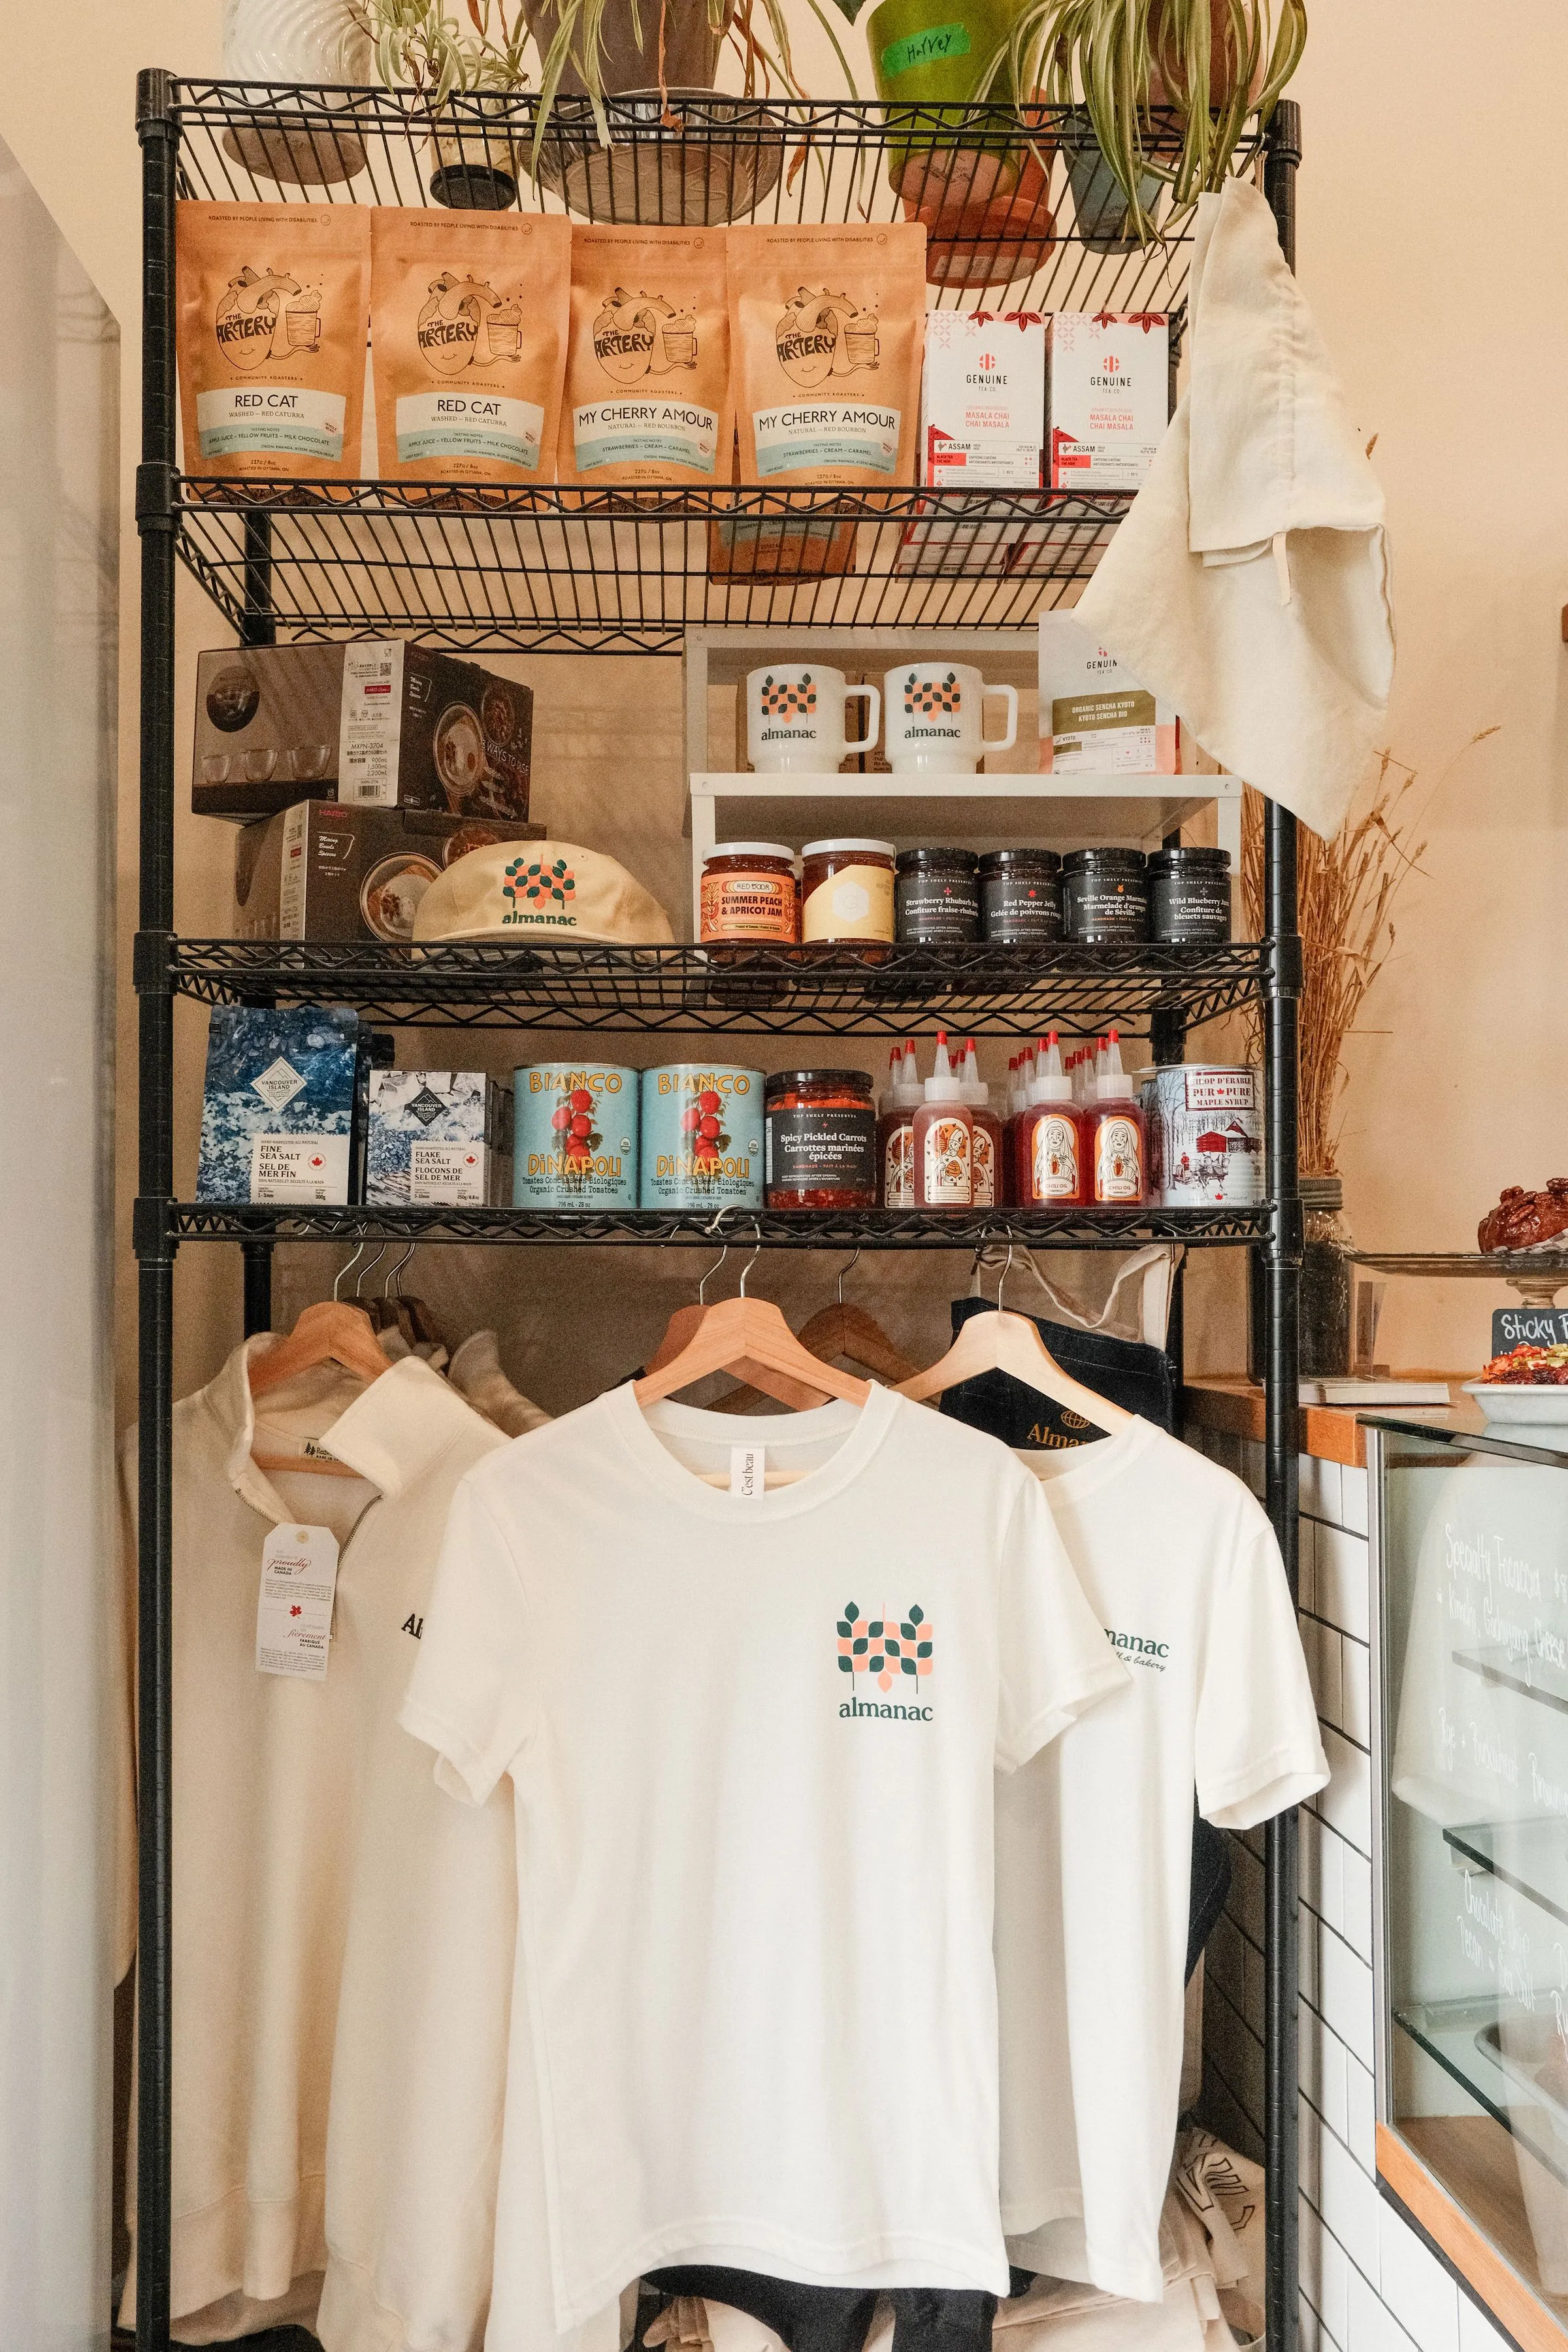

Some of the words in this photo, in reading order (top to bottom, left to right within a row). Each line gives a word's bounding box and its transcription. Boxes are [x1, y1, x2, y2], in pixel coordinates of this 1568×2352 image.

[216, 316, 276, 343] ARTERY
[418, 322, 478, 349] ARTERY
[594, 333, 654, 359] ARTERY
[777, 335, 836, 363] ARTERY
[966, 374, 1007, 384] GENUINE
[1090, 377, 1132, 387] GENUINE
[235, 394, 263, 407] RED
[267, 394, 299, 408] CAT
[438, 399, 466, 412] RED
[471, 401, 501, 416] CAT
[580, 410, 597, 427] MY
[601, 407, 657, 421] CHERRY
[662, 408, 712, 431] AMOUR
[759, 416, 777, 431] MY
[781, 410, 838, 426] CHERRY
[841, 410, 895, 430] AMOUR
[1086, 660, 1117, 669] GENUIN
[1072, 705, 1094, 713] ORGANIC
[1079, 714, 1095, 723] KYOTO
[761, 728, 817, 741] almanac
[904, 727, 961, 739] almanac
[481, 739, 485, 749] 3
[487, 741, 506, 764] WAYS
[508, 754, 516, 767] TO
[517, 760, 529, 776] USE
[318, 836, 338, 844] Mixing
[721, 896, 758, 905] SUMMER
[760, 896, 783, 907] PEACH
[906, 898, 944, 907] Strawberry
[1019, 900, 1043, 908] Pepper
[1044, 901, 1056, 909] Jelly
[1187, 898, 1220, 906] Blueberry
[721, 907, 728, 915] &
[730, 906, 765, 915] APRICOT
[767, 907, 783, 917] JAM
[1019, 908, 1049, 917] poivrons
[502, 911, 577, 926] almanac
[1201, 914, 1227, 923] sauvages
[529, 1071, 622, 1094] BIANCO
[658, 1072, 750, 1095] BIANCO
[1226, 1087, 1250, 1096] PURE
[781, 1135, 802, 1144] Spicy
[803, 1133, 837, 1141] Pickled
[838, 1134, 867, 1142] Carrots
[784, 1144, 826, 1152] Carrottes
[827, 1144, 864, 1152] marinées
[809, 1152, 842, 1161] épicées
[528, 1154, 621, 1177] DiNAPOLI
[656, 1154, 749, 1179] DiNAPOLI
[589, 1177, 627, 1186] Biologiques
[717, 1178, 755, 1187] Biologiques
[530, 1186, 554, 1195] Organic
[658, 1187, 683, 1196] Organic
[1501, 1314, 1557, 1347] Sticky
[742, 1454, 753, 1474] beau
[741, 1476, 753, 1495] C'est
[267, 1558, 312, 1575] proudly
[1445, 1522, 1492, 1614] Specialty
[1494, 1535, 1542, 1601] Focaccia
[283, 1629, 326, 1640] fièrement
[1535, 1616, 1566, 1670] Cheese
[1134, 1656, 1166, 1673] bakery
[839, 1697, 934, 1722] almanac
